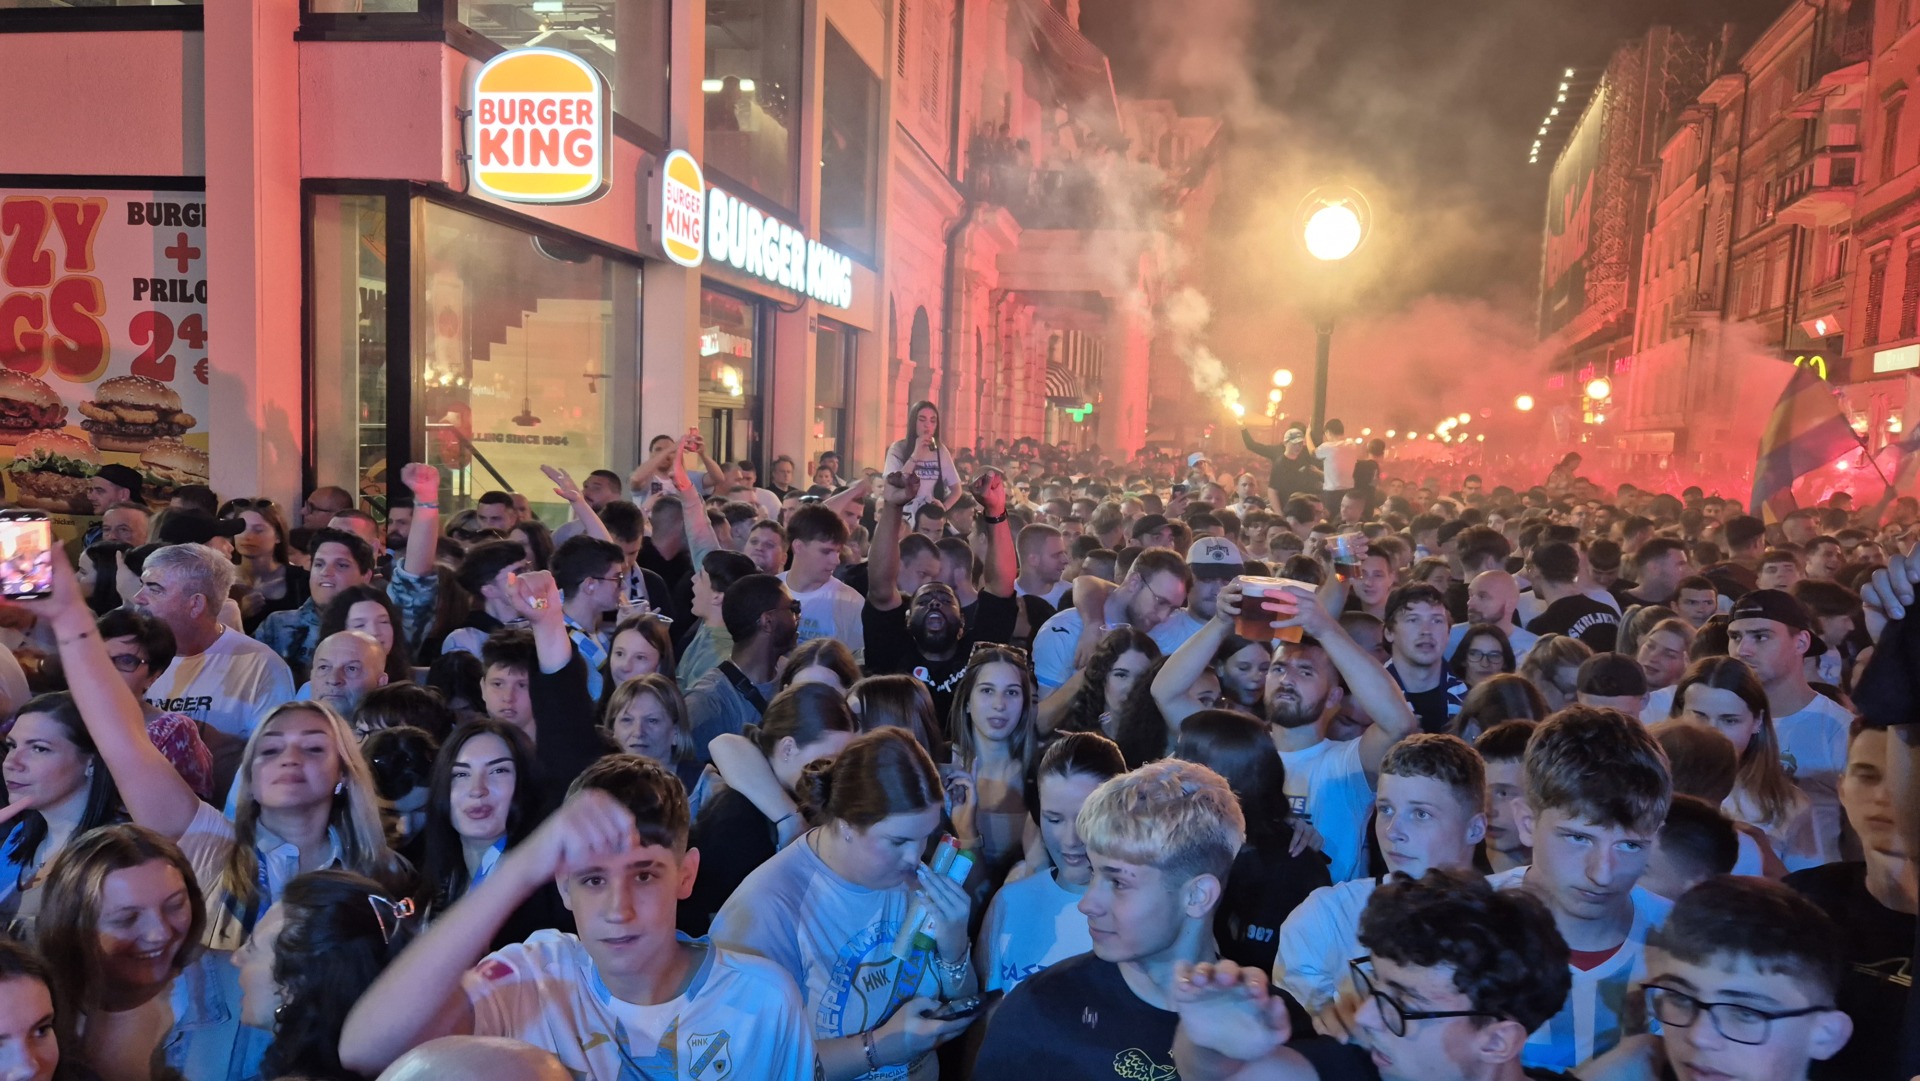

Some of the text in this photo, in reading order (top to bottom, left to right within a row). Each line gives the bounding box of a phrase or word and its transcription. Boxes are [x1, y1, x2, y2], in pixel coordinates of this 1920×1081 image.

[479, 98, 594, 126] BURGER
[479, 128, 594, 168] KING
[666, 181, 701, 215] BURGER
[666, 203, 700, 244] KING
[707, 186, 852, 310] BURGER KING
[505, 434, 541, 445] SINCE
[542, 435, 569, 446] 1954
[862, 967, 891, 993] HNK
[691, 1038, 709, 1047] HNK
